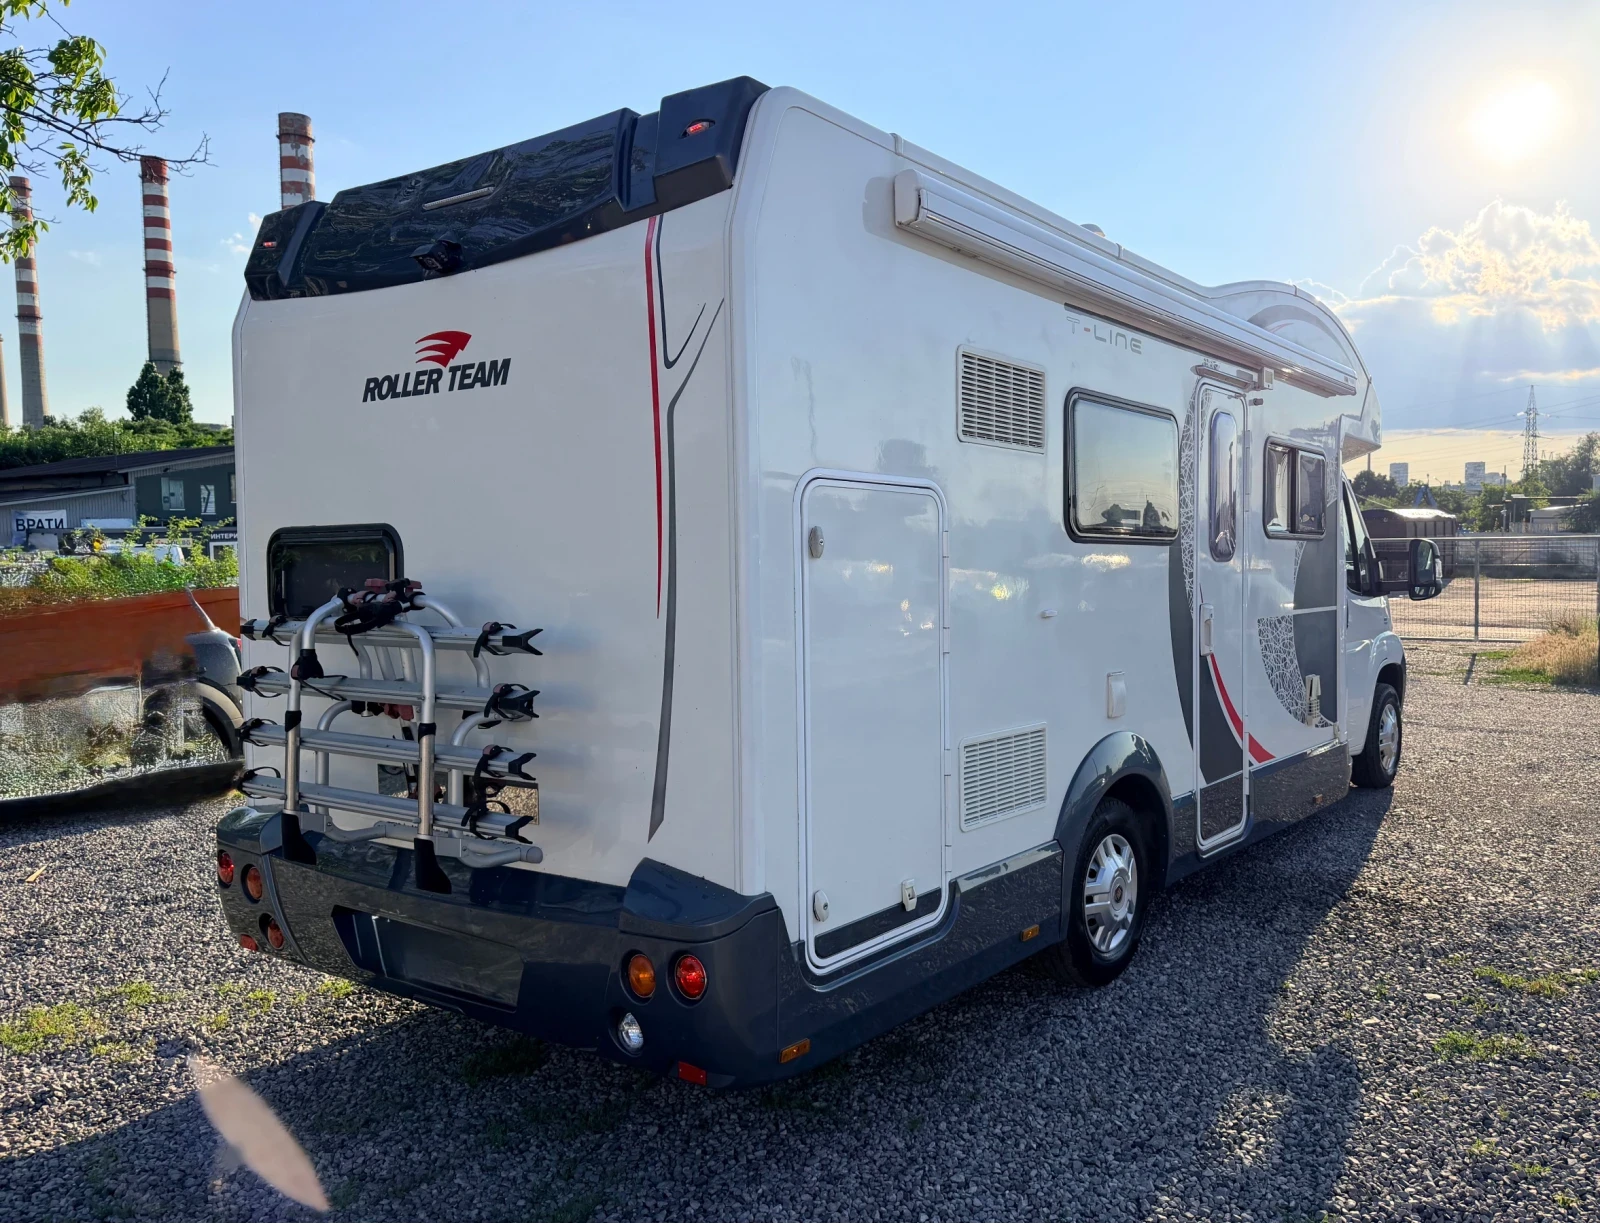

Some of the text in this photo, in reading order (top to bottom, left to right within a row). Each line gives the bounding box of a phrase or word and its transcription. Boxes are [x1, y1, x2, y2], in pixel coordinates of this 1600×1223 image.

[1066, 316, 1142, 354] T-LINE
[362, 358, 511, 402] ROLLER TEAM
[15, 518, 64, 531] ВРАТИ
